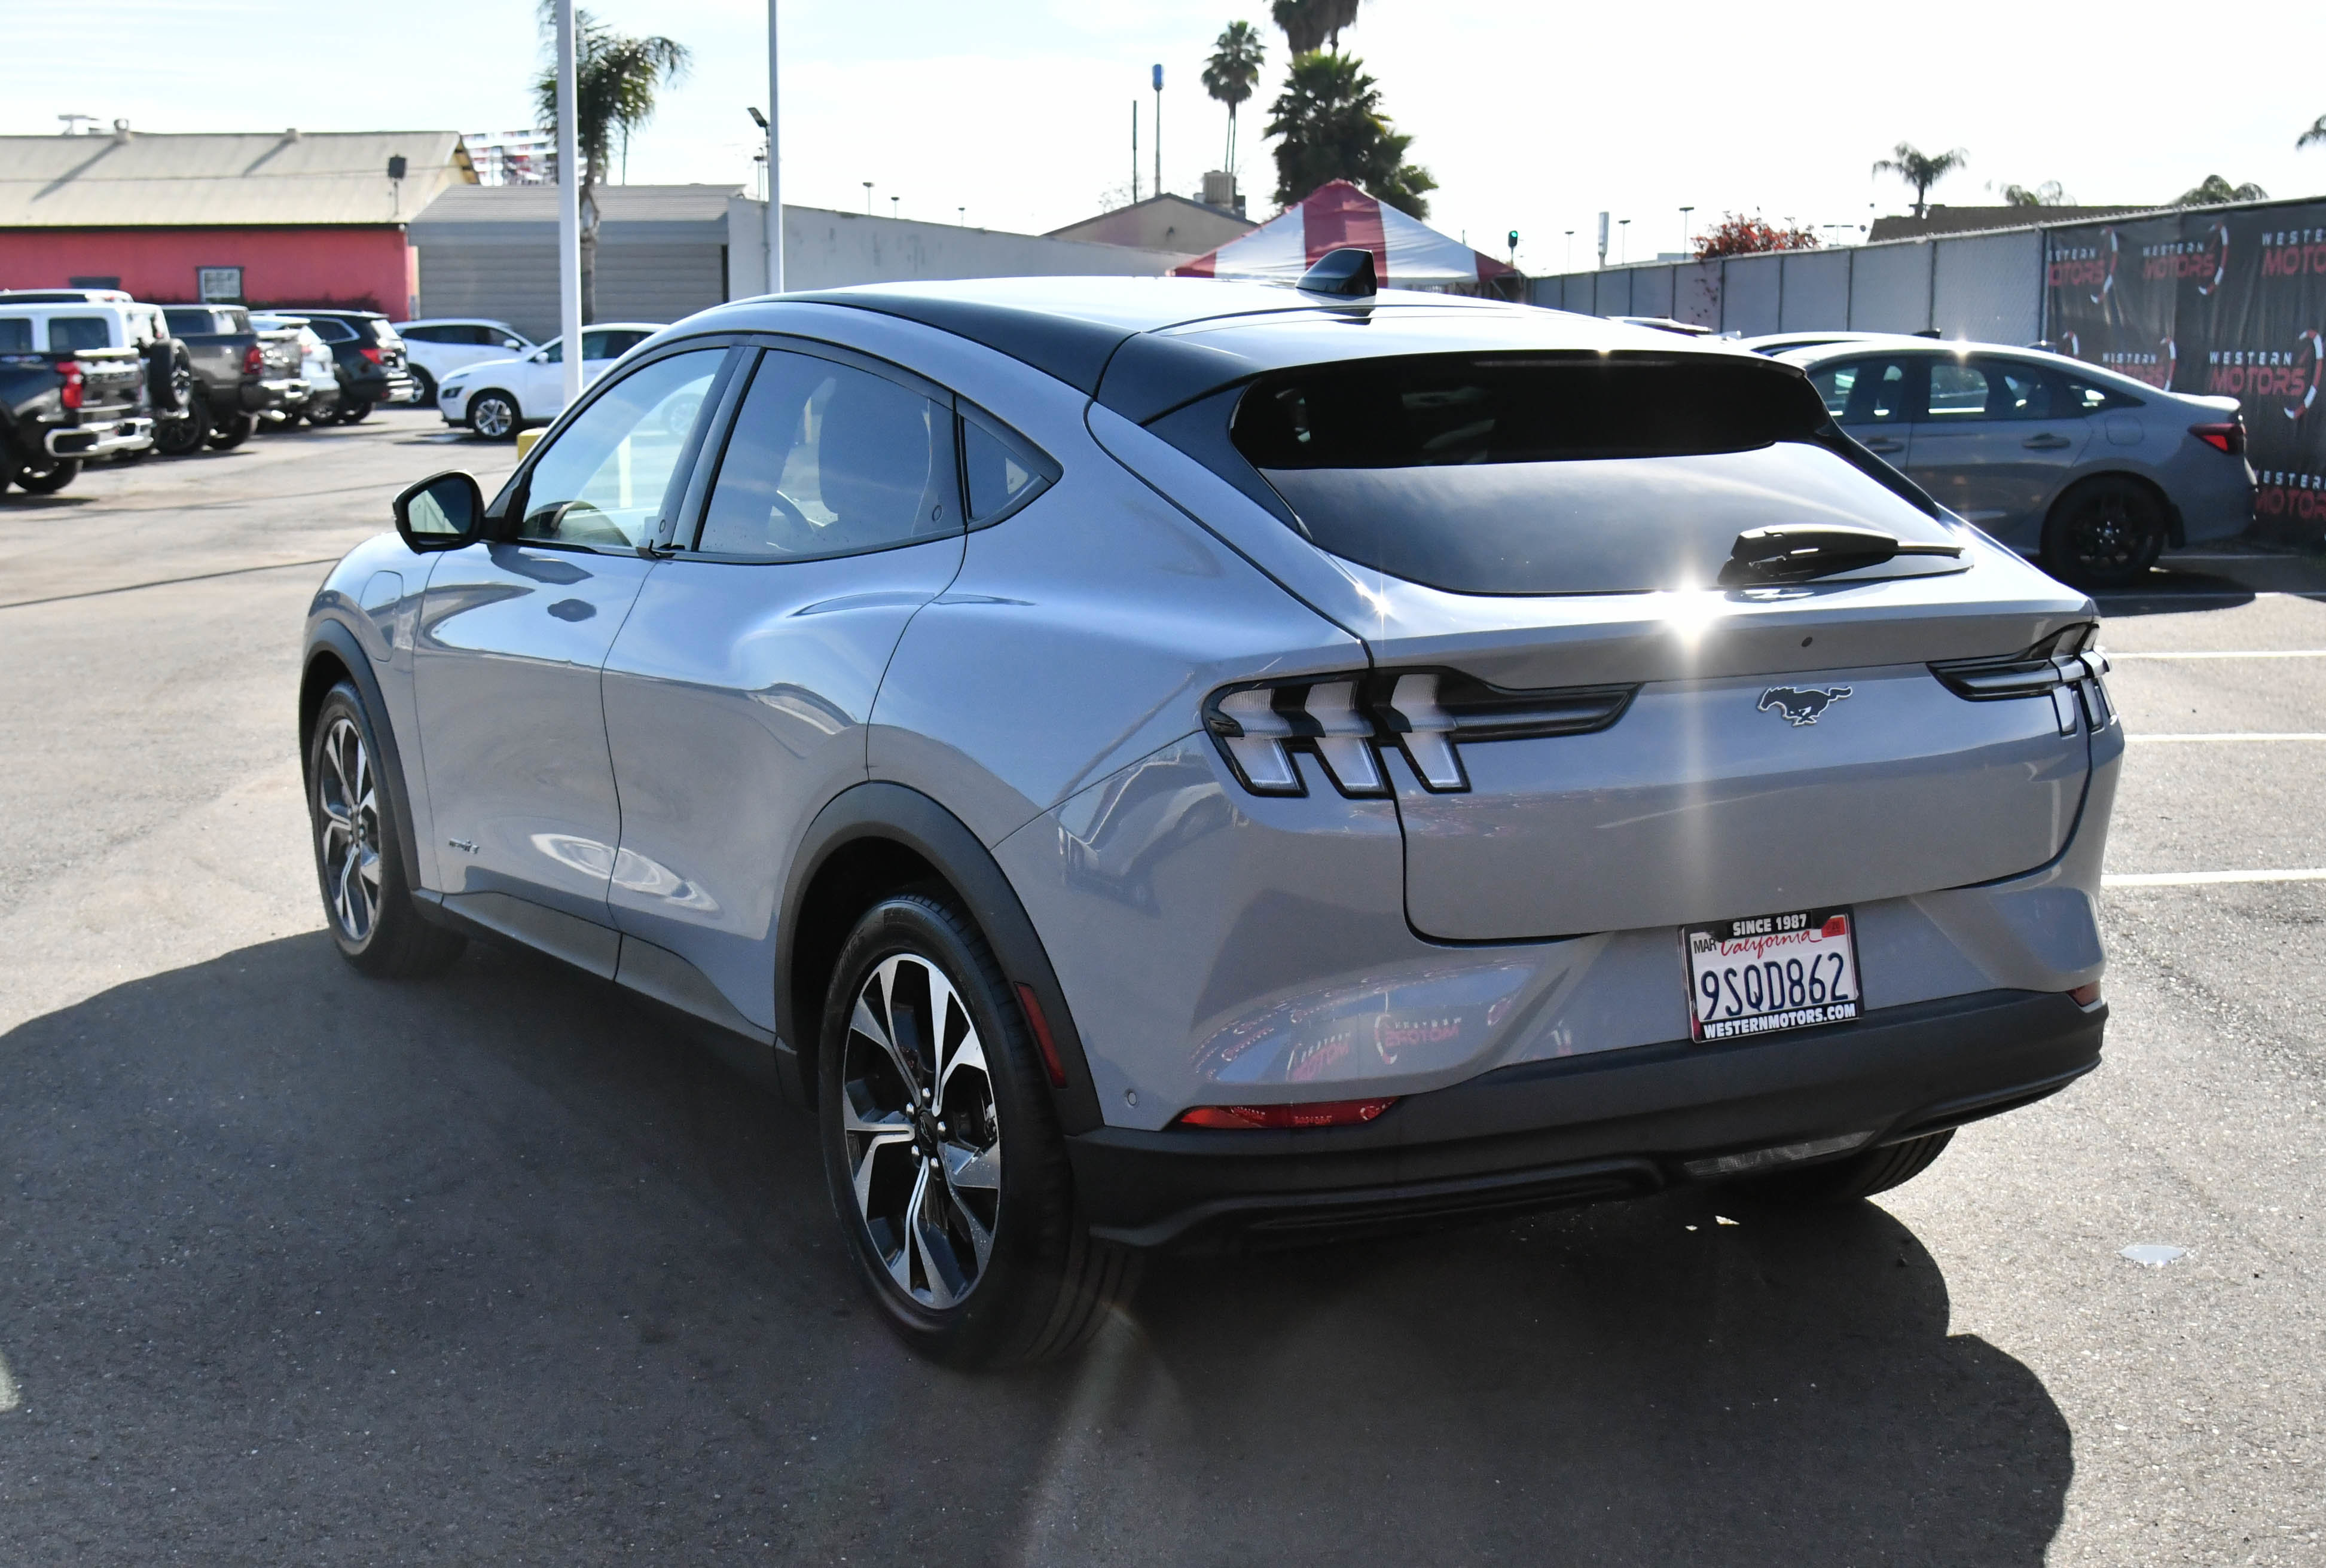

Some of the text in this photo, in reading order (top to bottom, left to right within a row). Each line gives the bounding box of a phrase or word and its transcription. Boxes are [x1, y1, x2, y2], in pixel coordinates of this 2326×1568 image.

[2209, 351, 2293, 366] WESTERN
[2209, 366, 2306, 396] MOTORS
[1733, 913, 1807, 936] SINCE 1987
[1693, 939, 1717, 954] MAR
[1720, 930, 1822, 959] California
[1701, 952, 1848, 1020] 9SQD862
[1704, 1004, 1856, 1039] WESTERNMOTORS.COM
